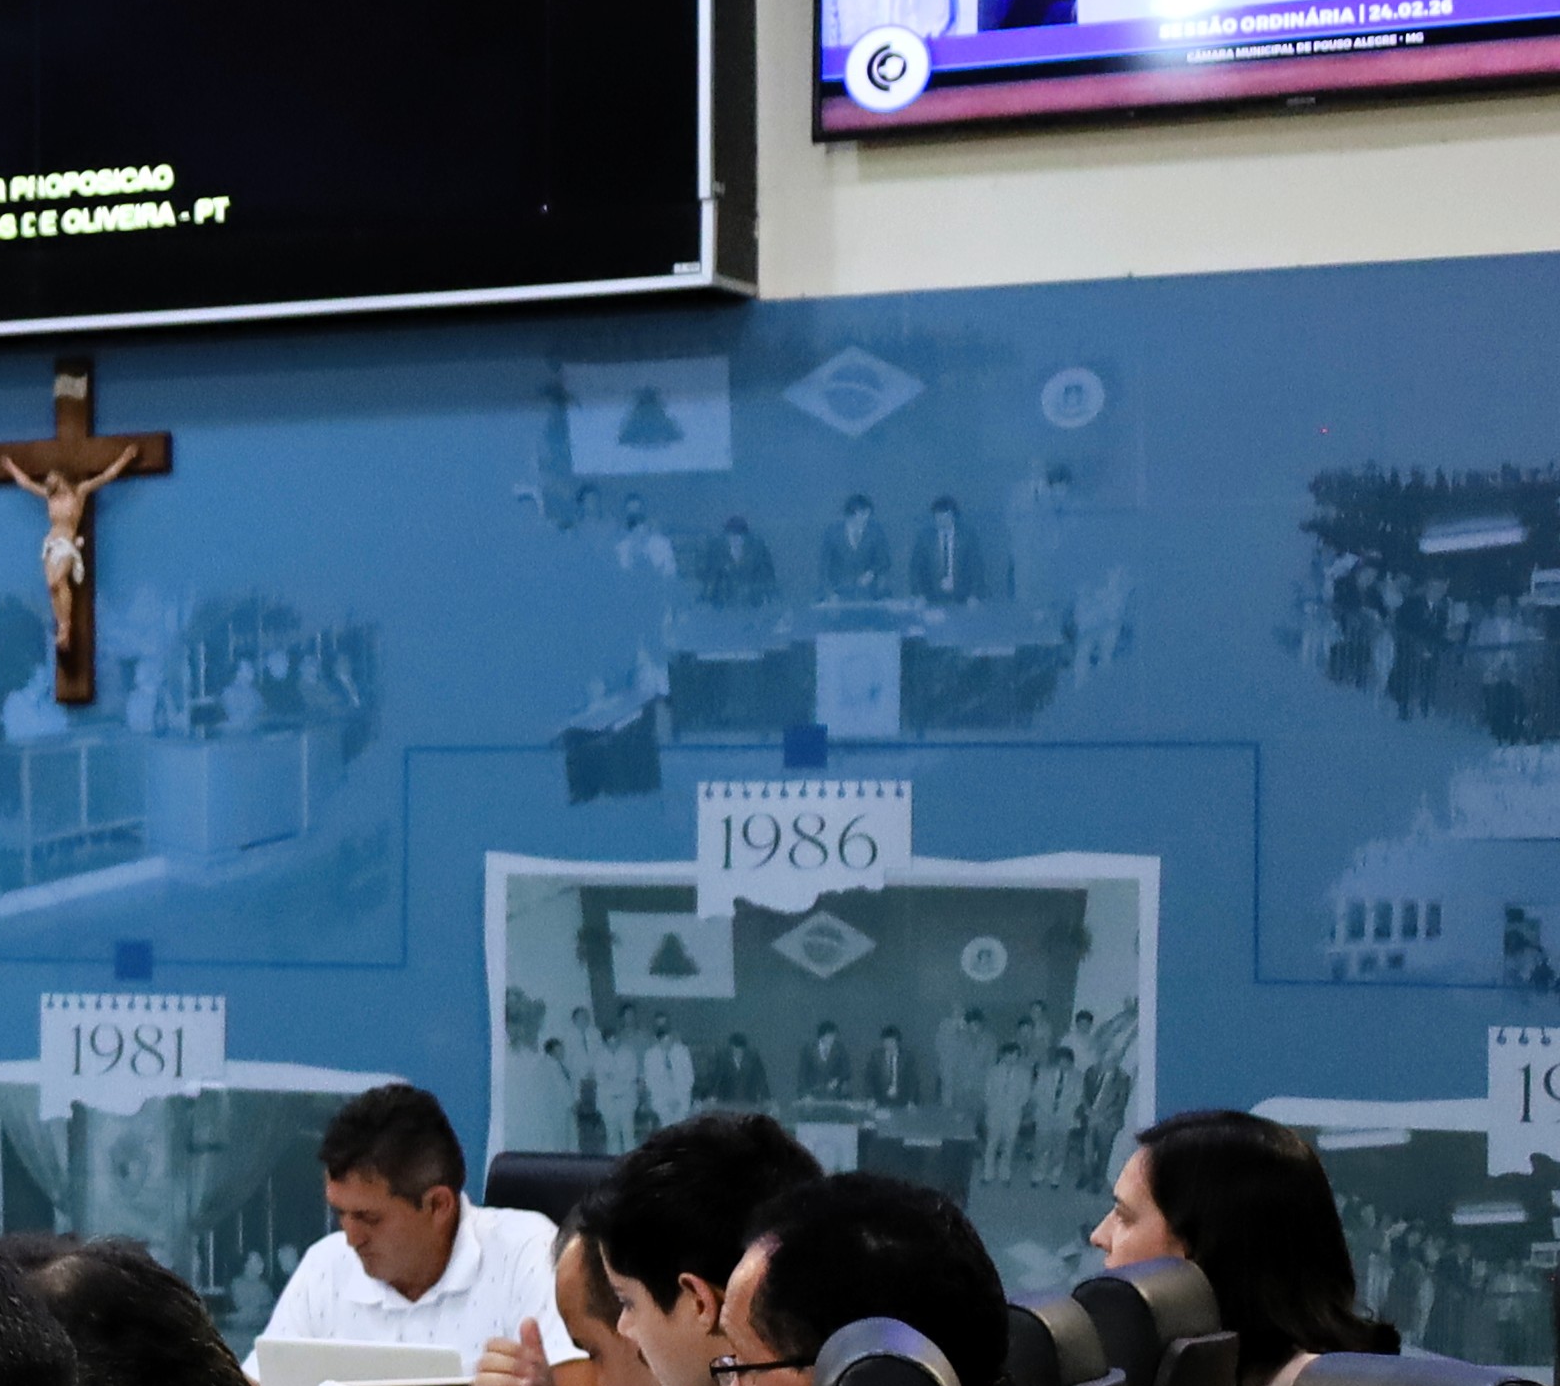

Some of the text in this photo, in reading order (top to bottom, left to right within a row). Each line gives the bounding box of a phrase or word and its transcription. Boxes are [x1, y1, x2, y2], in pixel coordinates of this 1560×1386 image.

[1240, 6, 1355, 35] ORDINÁRIA
[1296, 41, 1312, 55] DE
[1353, 33, 1397, 49] ALEGRE
[60, 200, 177, 236] OLIVEIRA
[194, 196, 230, 225] PT
[719, 812, 881, 871] 1986
[70, 1023, 187, 1079] 1981
